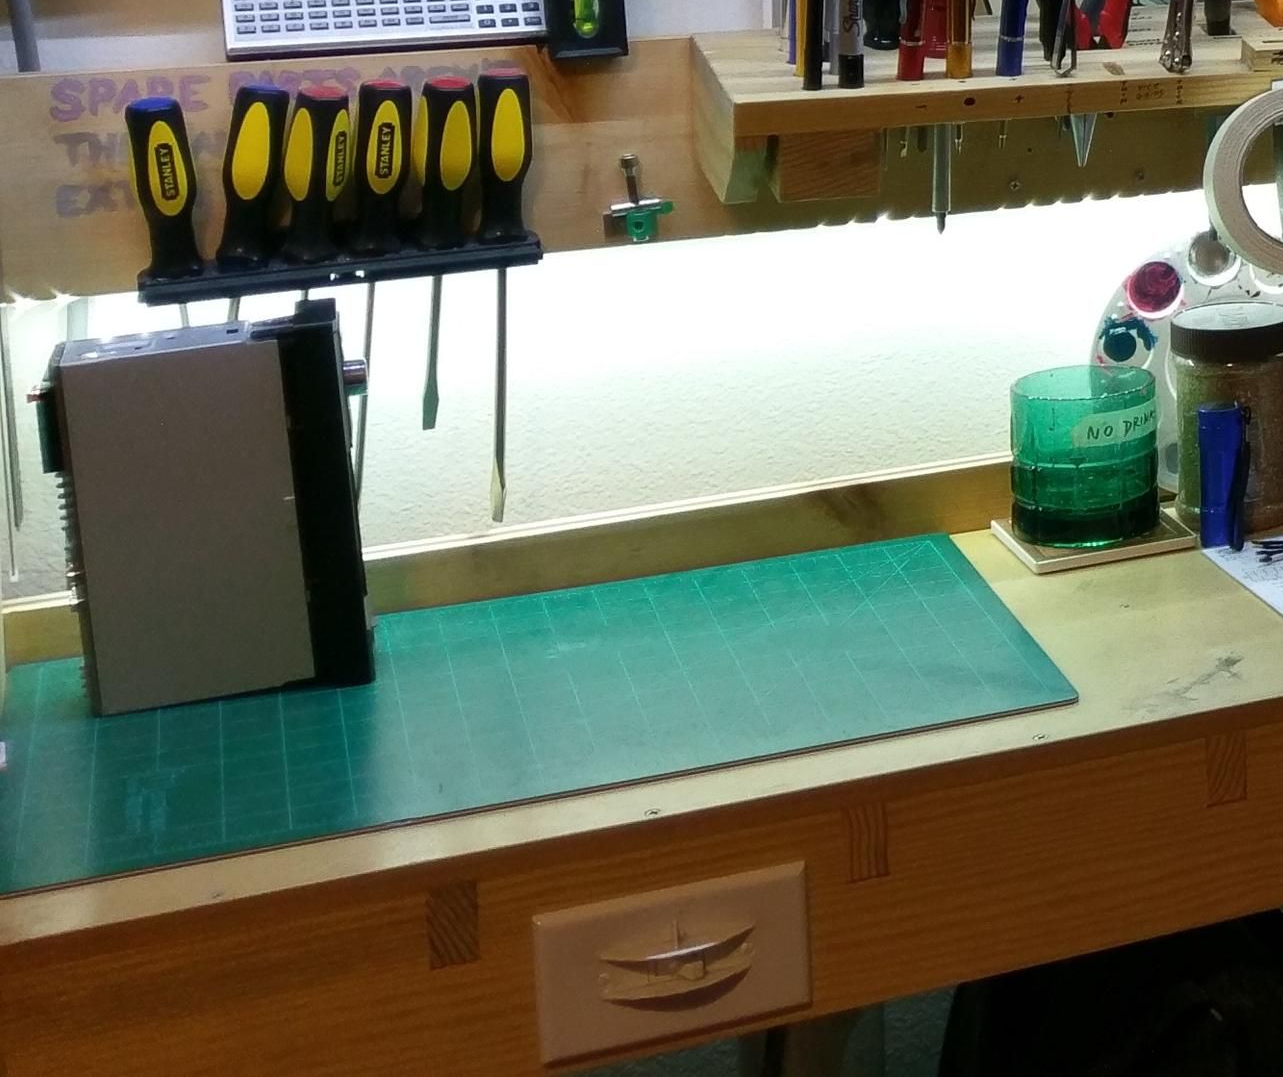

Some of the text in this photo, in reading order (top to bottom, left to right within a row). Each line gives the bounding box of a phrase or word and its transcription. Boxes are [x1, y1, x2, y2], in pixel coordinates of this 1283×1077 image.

[49, 73, 210, 122] SPARE
[158, 146, 178, 198] STANLEY
[333, 134, 345, 184] STANLEY
[379, 126, 394, 176] STANLEY
[1087, 425, 1114, 440] NO
